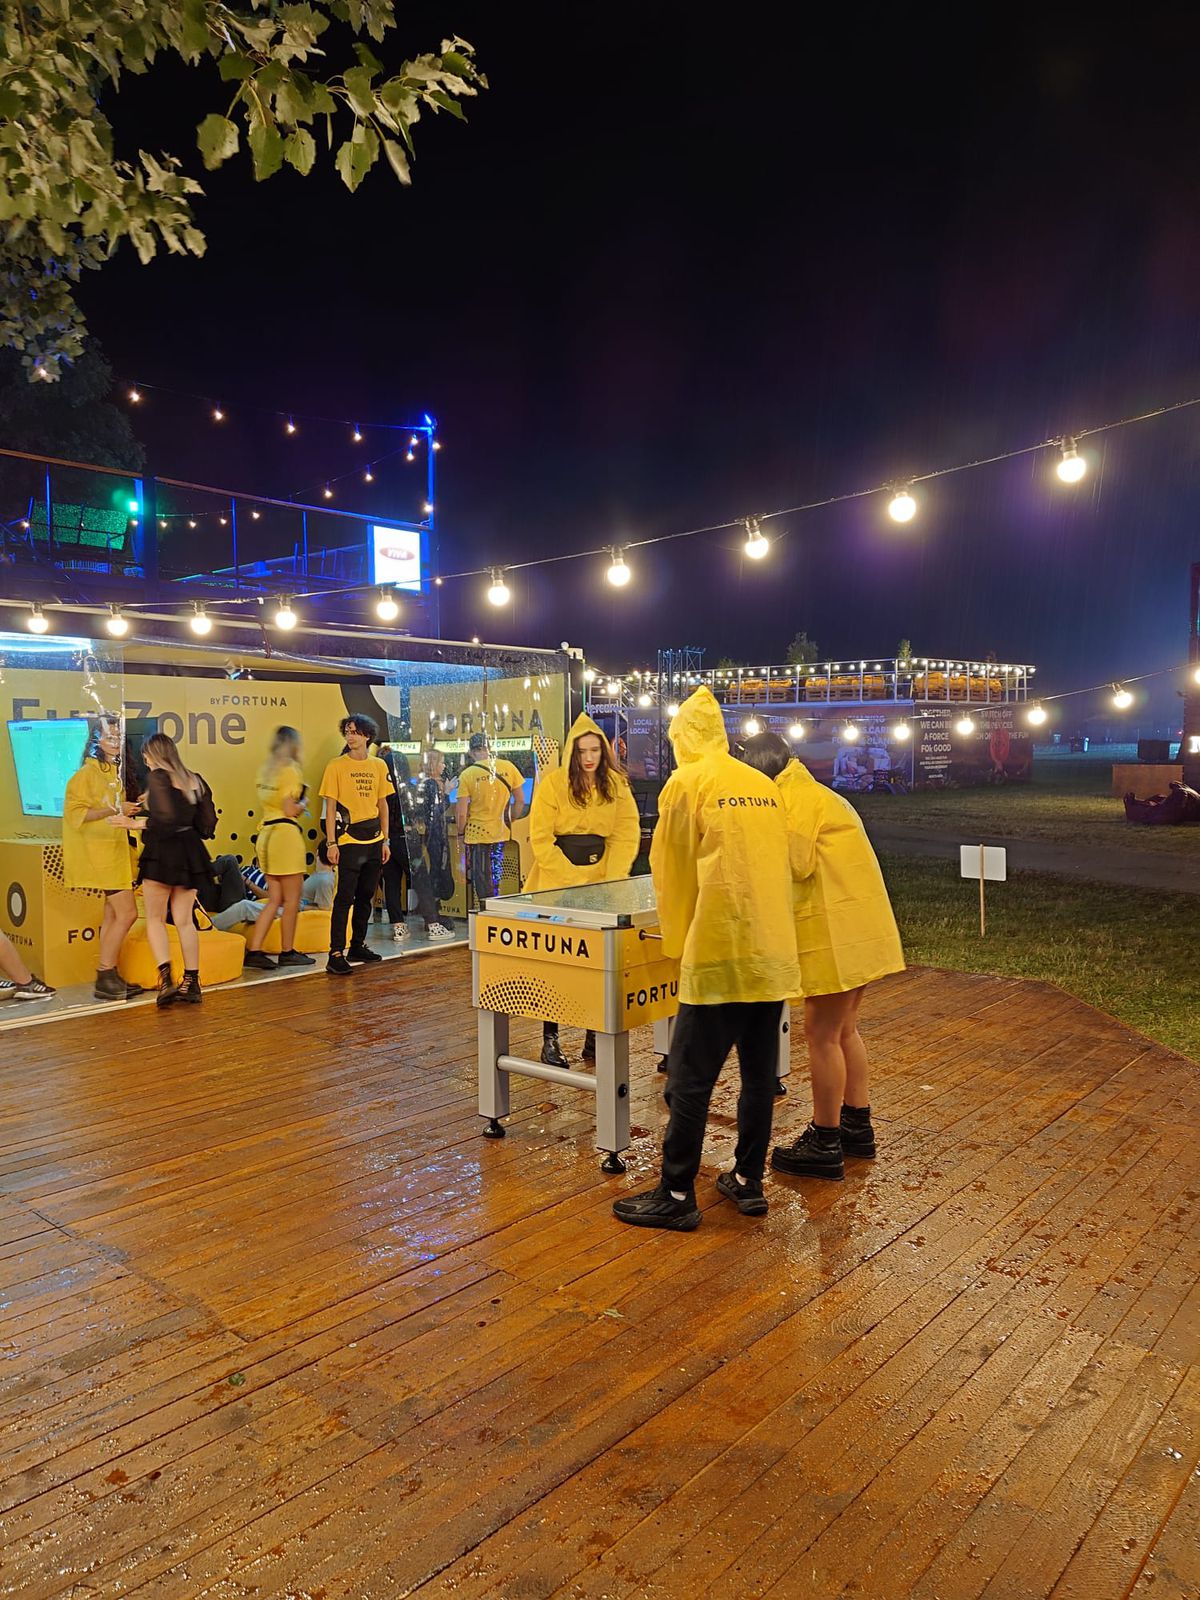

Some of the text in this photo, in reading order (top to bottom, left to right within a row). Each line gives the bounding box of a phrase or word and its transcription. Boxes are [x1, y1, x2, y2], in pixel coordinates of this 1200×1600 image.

[222, 695, 288, 707] FORTUNA
[585, 702, 620, 714] tercard
[429, 709, 543, 735] FORTUNA
[920, 721, 931, 729] WE
[931, 721, 944, 729] CAN
[929, 732, 949, 740] FORCE
[933, 744, 952, 752] GOOD
[718, 797, 778, 809] FORTUNA
[487, 926, 590, 958] FORTUNA
[626, 980, 678, 1010] FORTU
